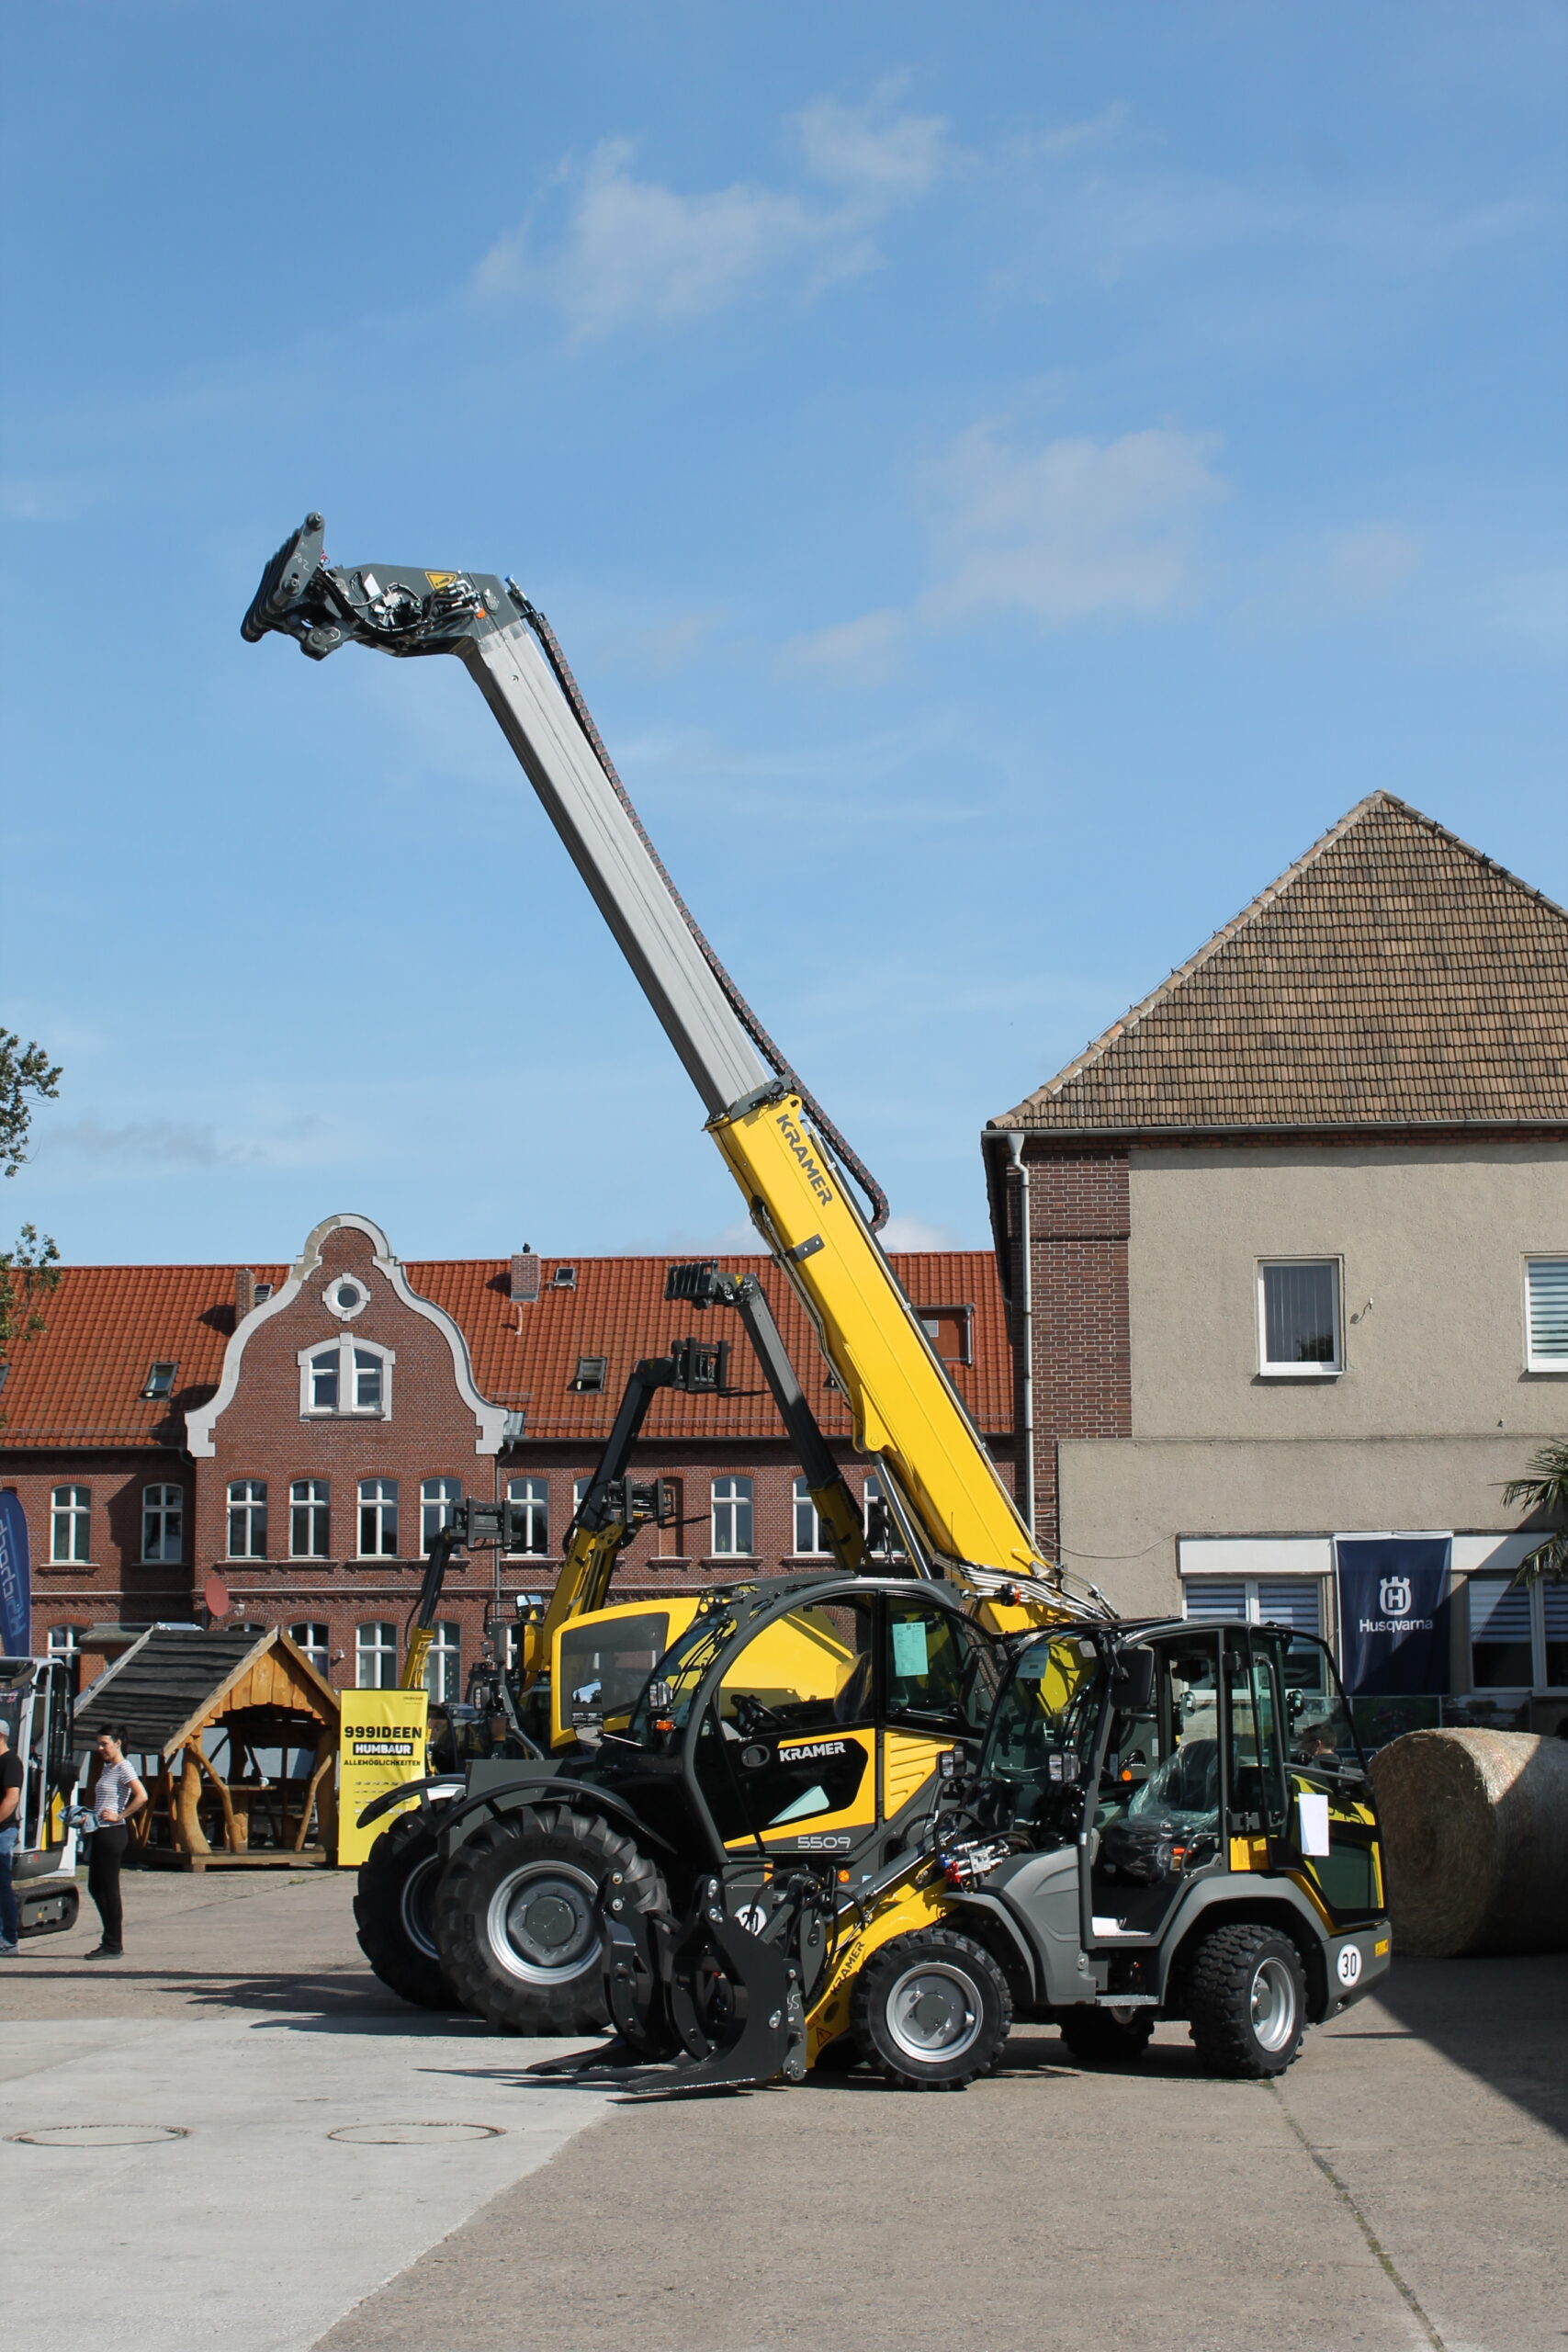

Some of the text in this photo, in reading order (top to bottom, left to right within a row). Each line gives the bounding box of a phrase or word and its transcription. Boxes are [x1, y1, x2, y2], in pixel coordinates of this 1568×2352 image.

[776, 1114, 832, 1207] KRAMER
[1359, 1619, 1433, 1634] Husqvarna
[344, 1726, 422, 1738] 999IDEEN
[355, 1745, 411, 1754] HUMBAUR
[779, 1741, 846, 1762] KRAMER
[797, 1837, 851, 1849] 5509
[829, 1940, 865, 1996] KRAMER
[1342, 1952, 1356, 1977] 30
